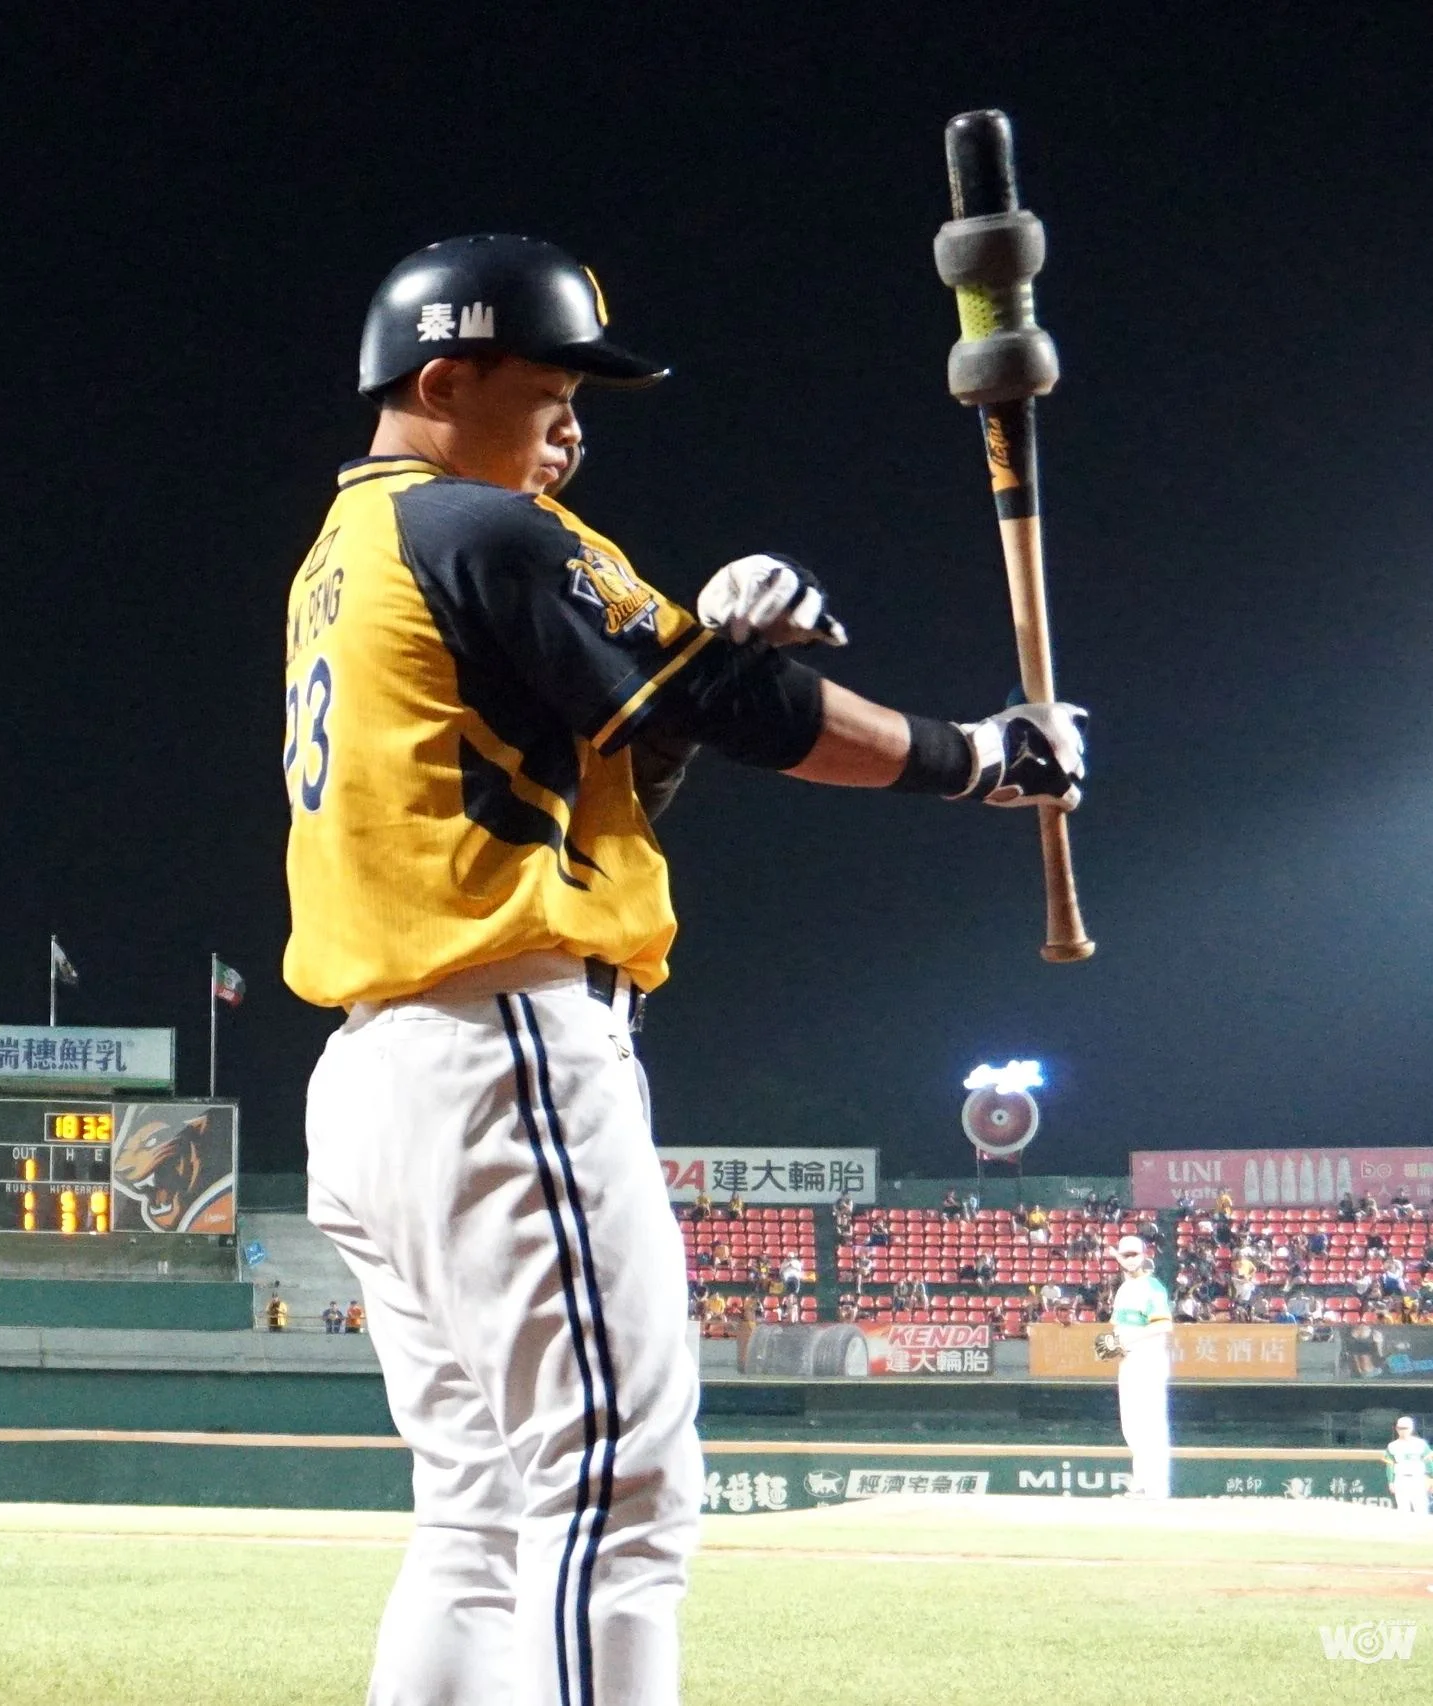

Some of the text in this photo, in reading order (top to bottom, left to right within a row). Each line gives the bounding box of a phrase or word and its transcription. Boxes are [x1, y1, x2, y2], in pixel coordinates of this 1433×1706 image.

[417, 302, 494, 342] 泰山
[12, 1147, 37, 1160] OUT
[66, 1149, 75, 1160] H
[94, 1151, 103, 1162] E
[711, 1158, 864, 1192] 建大輪胎
[1167, 1159, 1222, 1182] UNI
[5, 1183, 33, 1193] RUNS
[49, 1185, 71, 1194] HITS
[887, 1325, 990, 1349] KENDA
[885, 1350, 989, 1374] 建大輪胎
[856, 1474, 979, 1495] 經濟宅急便
